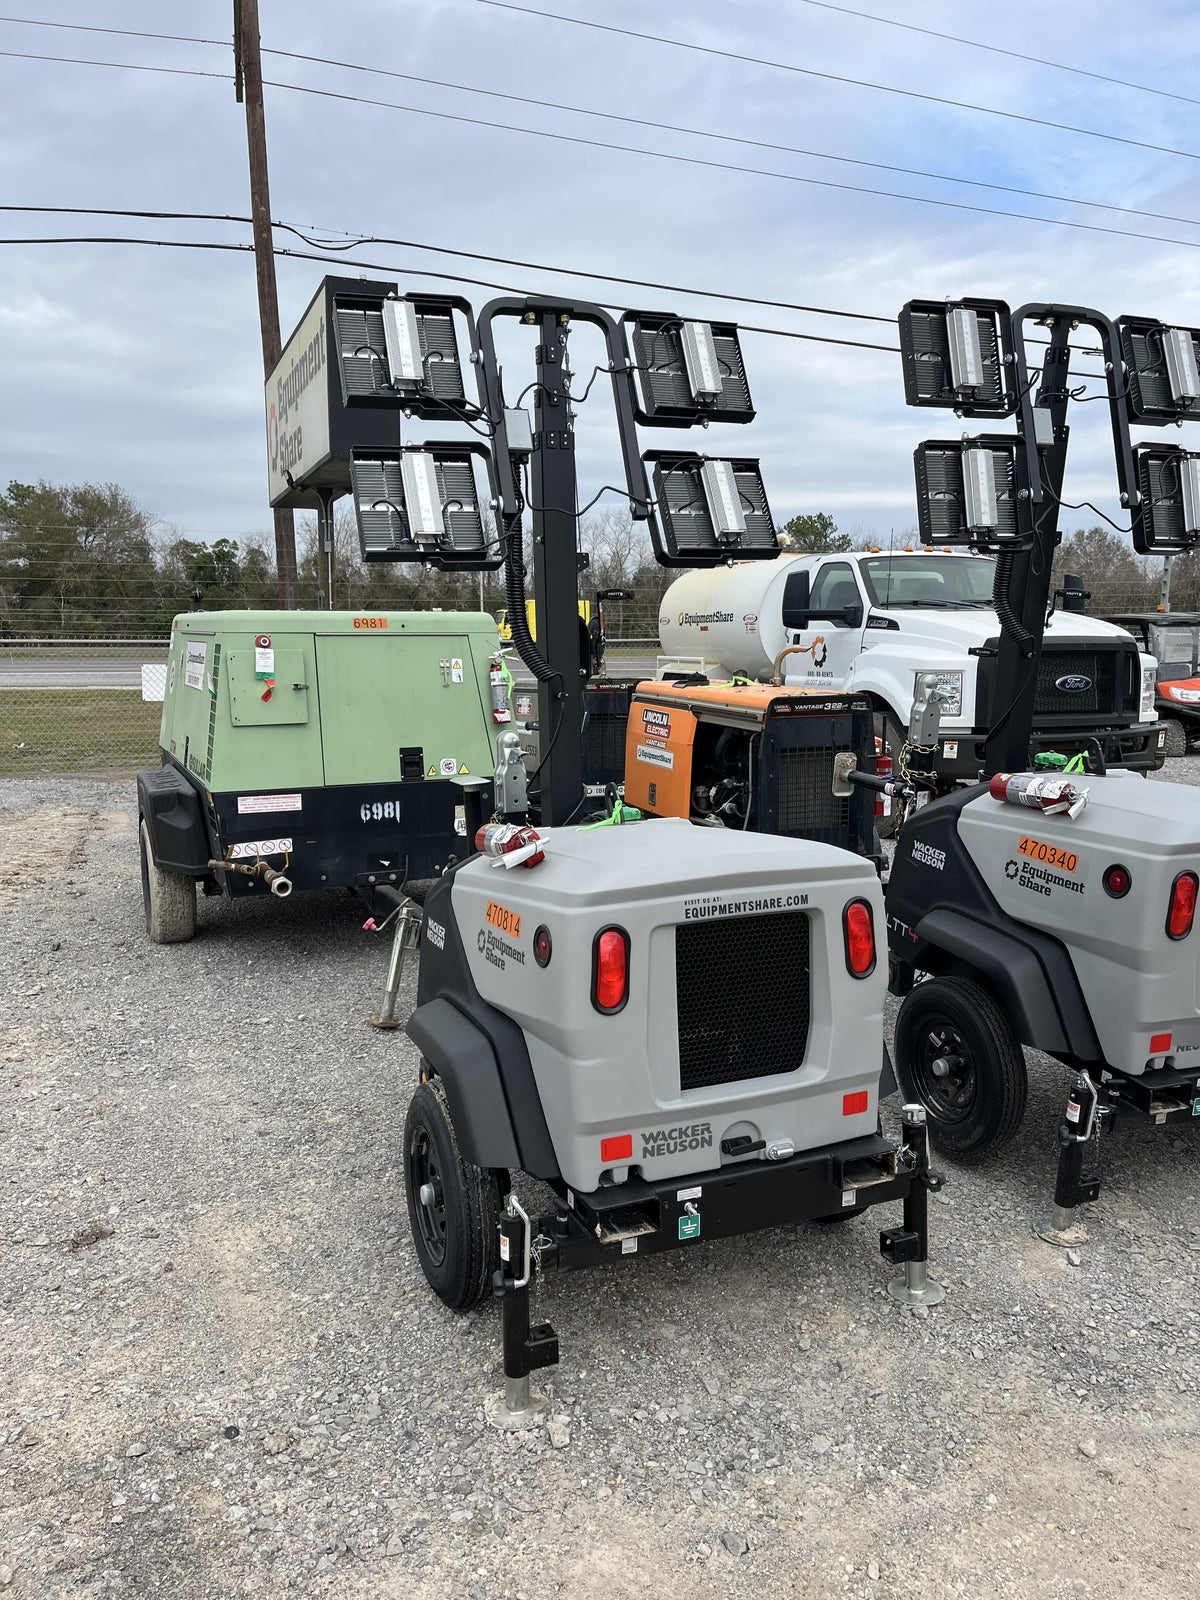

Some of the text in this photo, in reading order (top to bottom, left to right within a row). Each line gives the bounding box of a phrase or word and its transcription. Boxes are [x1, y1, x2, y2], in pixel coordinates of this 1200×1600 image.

[277, 316, 326, 423] Equipment
[279, 425, 303, 475] Share
[353, 618, 383, 629] 6981
[684, 611, 734, 626] EquipmentShare
[1065, 678, 1086, 689] Ford
[643, 710, 669, 726] LINCOLN
[646, 724, 669, 737] ELECTRIC
[645, 738, 667, 749] VANTAGE
[641, 750, 672, 764] EquipmentShare
[360, 801, 400, 823] 6981
[911, 849, 945, 871] NEUSON
[913, 840, 946, 861] WACKER
[1019, 839, 1077, 871] 470340
[1018, 874, 1051, 896] Share
[1021, 862, 1085, 894] Equipment
[685, 894, 809, 919] EQUIPMENTSHARE.COM
[428, 917, 446, 939] WACKER
[486, 902, 521, 936] 470814
[886, 913, 918, 943] LTT4
[426, 926, 445, 951] NEUSON
[487, 930, 525, 965] Equipment
[485, 946, 506, 970] Share
[641, 1122, 713, 1145] WACKER
[642, 1135, 713, 1158] NEUSON
